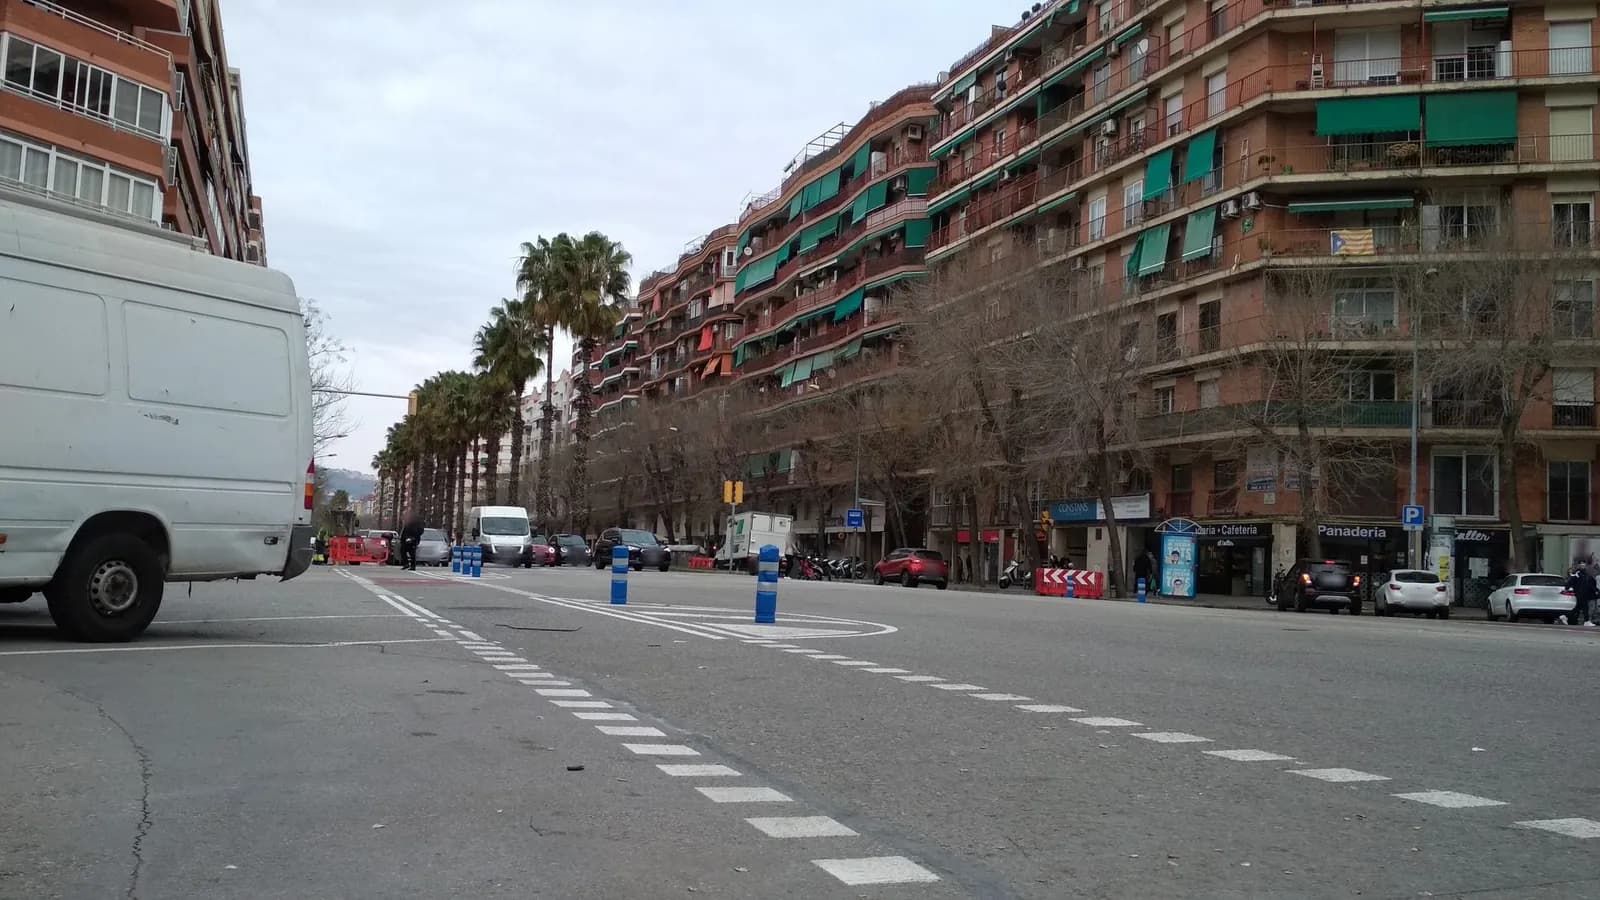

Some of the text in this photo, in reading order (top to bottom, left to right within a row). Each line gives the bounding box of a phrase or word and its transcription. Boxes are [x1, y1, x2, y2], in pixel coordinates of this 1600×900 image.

[1405, 507, 1420, 523] P
[1221, 525, 1258, 535] Cafeteria
[1317, 525, 1386, 538] Panaderia
